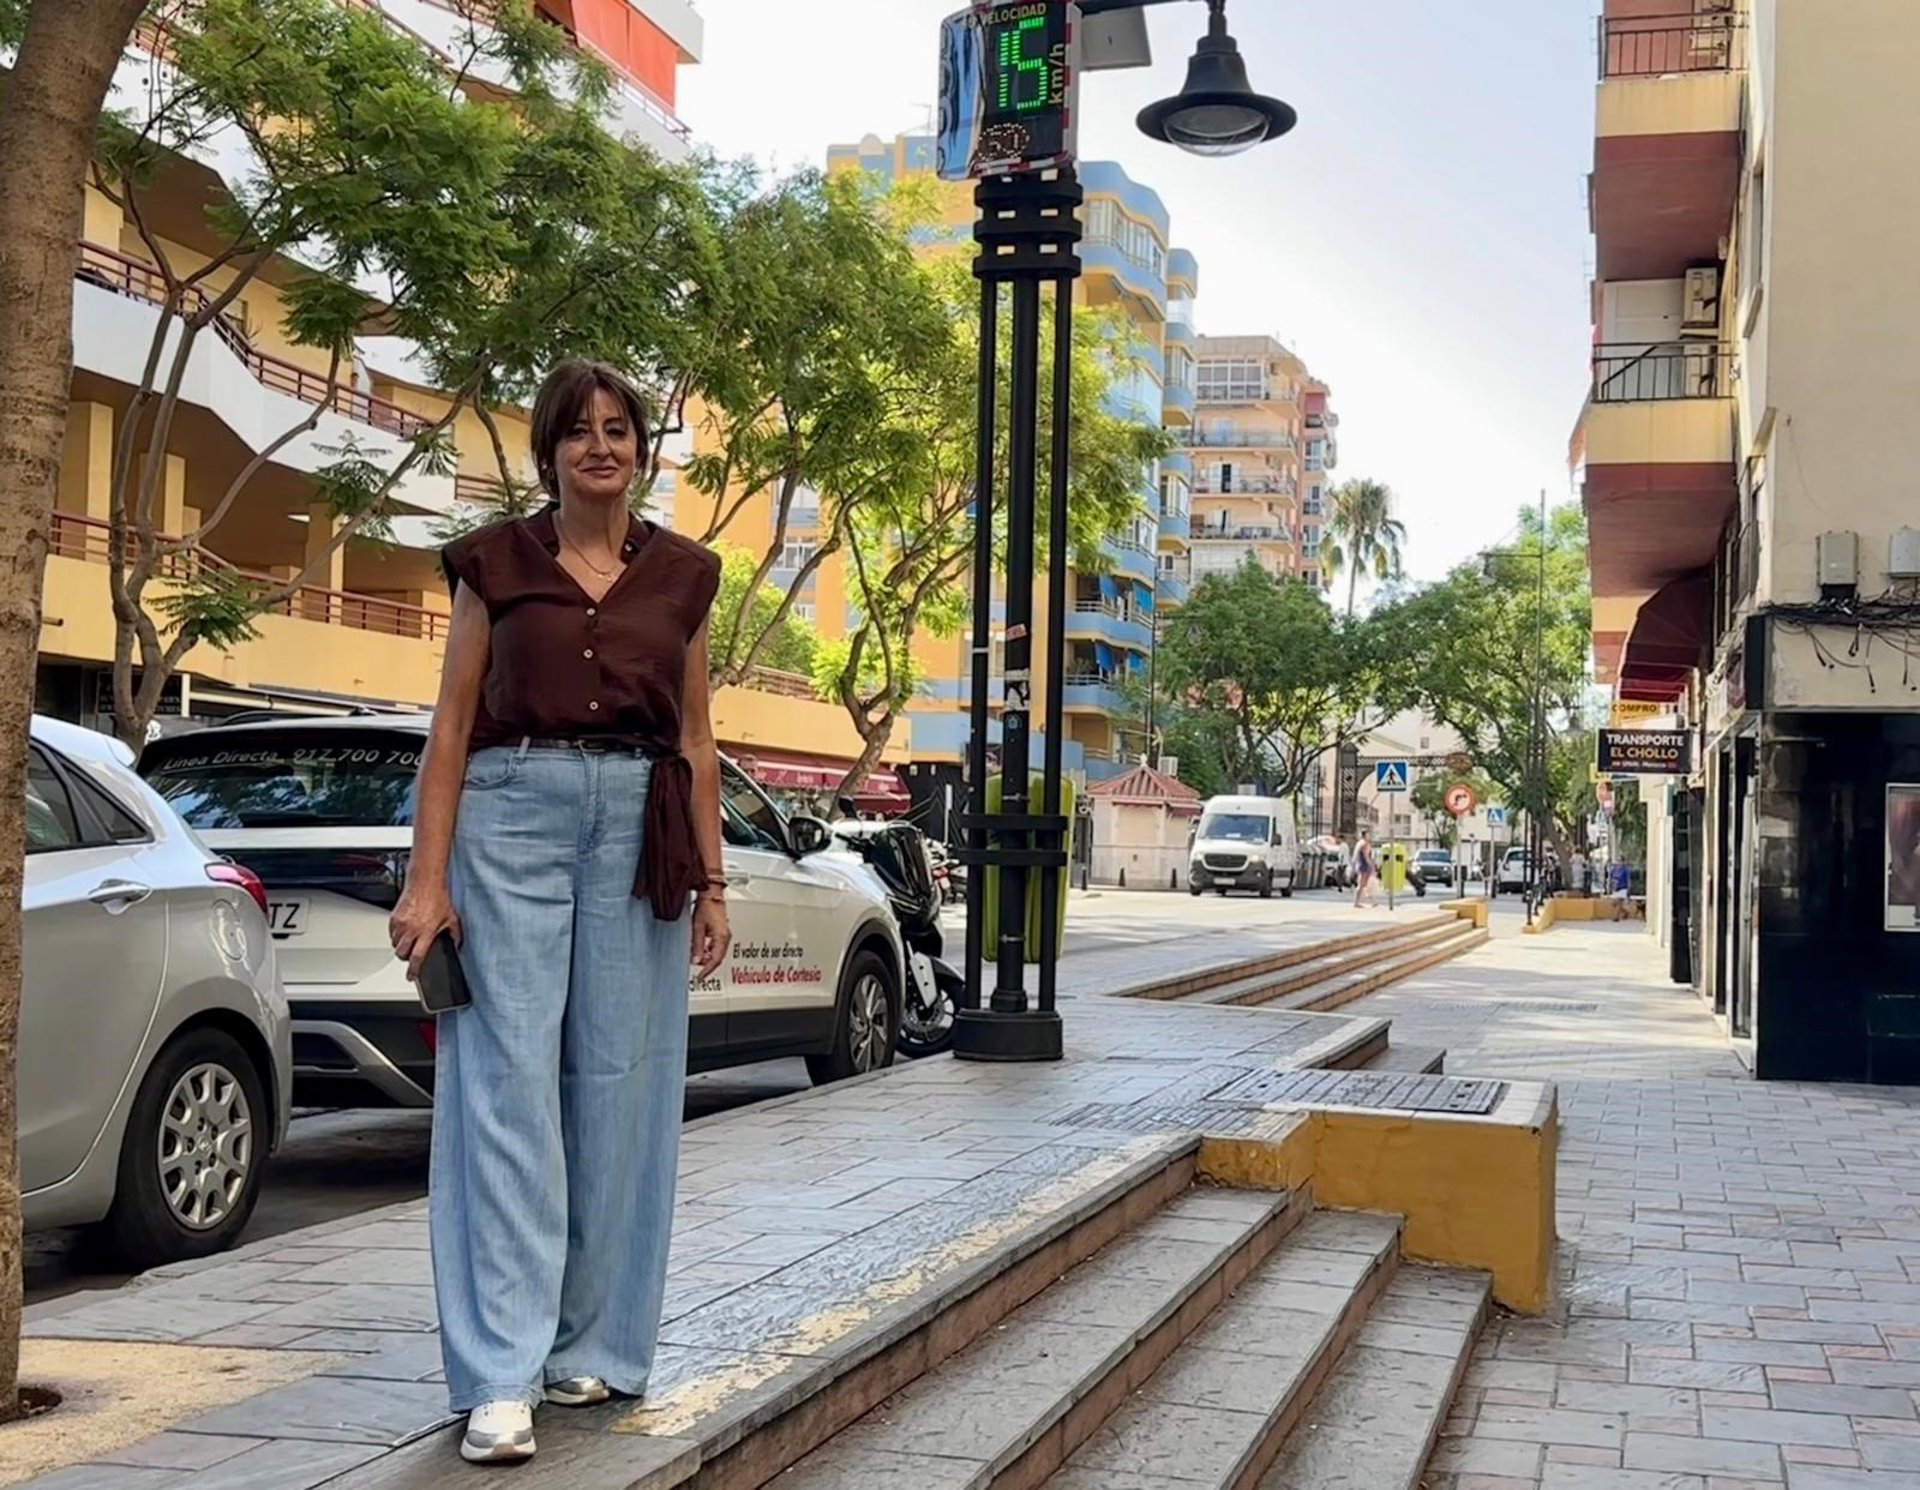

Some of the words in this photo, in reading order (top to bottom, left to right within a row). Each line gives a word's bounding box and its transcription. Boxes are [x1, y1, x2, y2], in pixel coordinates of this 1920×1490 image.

[981, 3, 1047, 27] VELOCIDAD
[999, 17, 1049, 110] 15
[1048, 43, 1064, 104] km/h
[1612, 703, 1657, 713] COMPRO
[1606, 734, 1684, 747] TRANSPORTE
[212, 751, 278, 764] Directa
[338, 748, 379, 762] 700
[1610, 747, 1624, 758] EL
[1627, 747, 1679, 759] CHOLLO
[269, 903, 300, 929] TZ
[733, 942, 740, 958] El
[741, 942, 760, 958] valor
[761, 942, 770, 958] de
[771, 947, 781, 958] ser
[773, 965, 785, 983] de
